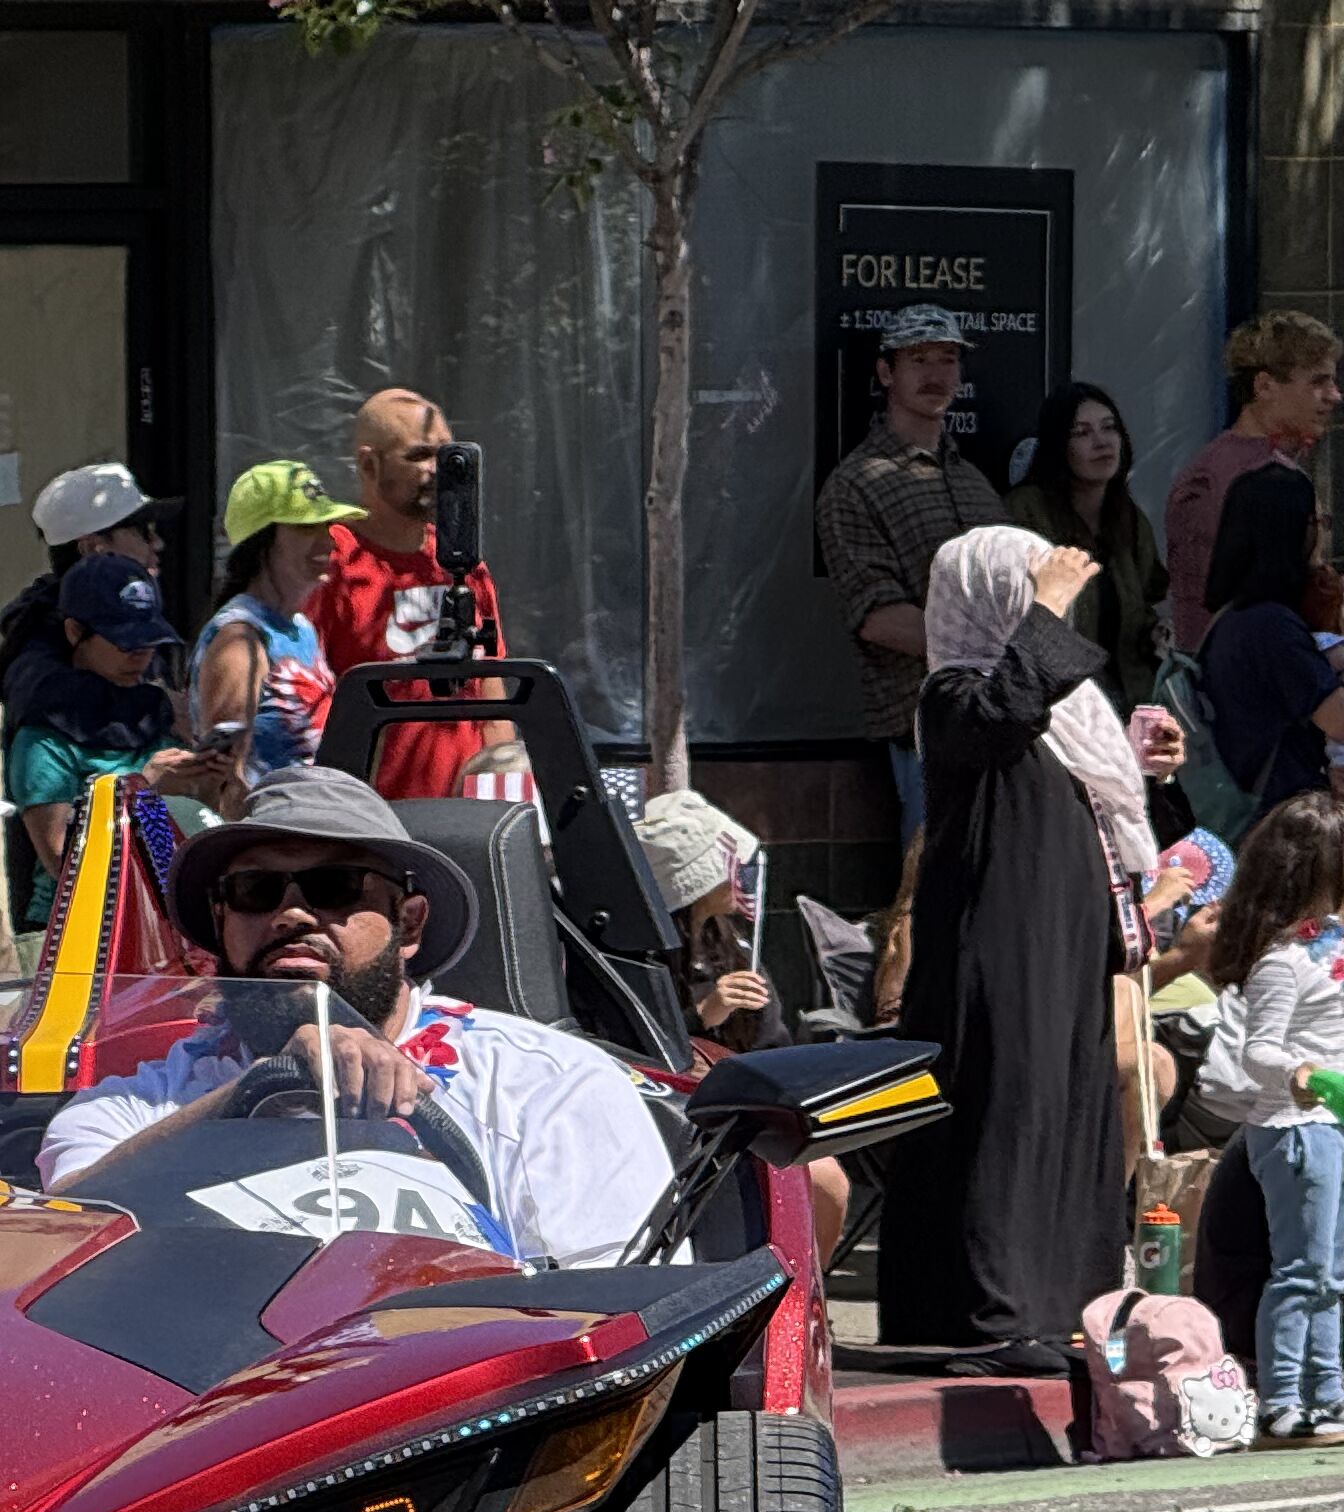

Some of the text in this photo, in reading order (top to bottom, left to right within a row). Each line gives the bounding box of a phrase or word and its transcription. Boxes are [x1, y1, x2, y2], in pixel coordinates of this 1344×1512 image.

[841, 253, 987, 290] FOR LEASE
[990, 312, 1037, 332] SPACE
